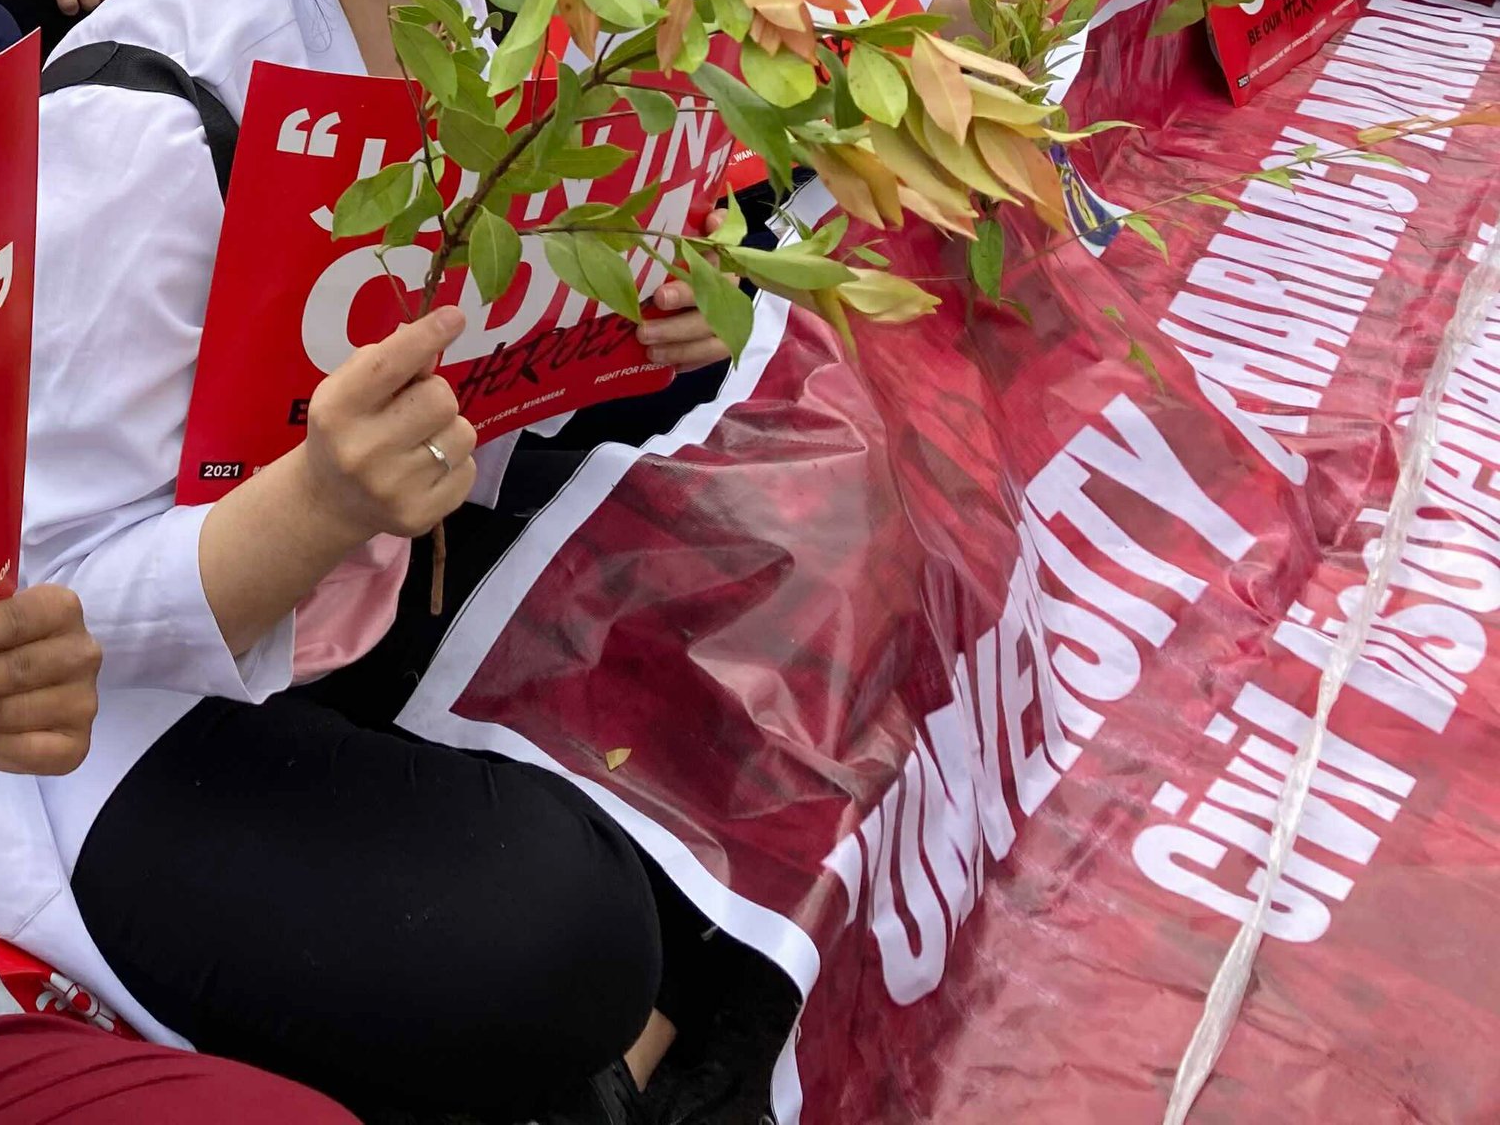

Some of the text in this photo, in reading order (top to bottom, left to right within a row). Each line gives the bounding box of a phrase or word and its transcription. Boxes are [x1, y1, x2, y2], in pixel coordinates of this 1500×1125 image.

[1247, 28, 1262, 46] BE
[1262, 14, 1282, 36] OUR
[594, 367, 620, 384] FIGHT
[621, 364, 640, 379] FOR
[203, 463, 240, 479] 2021
